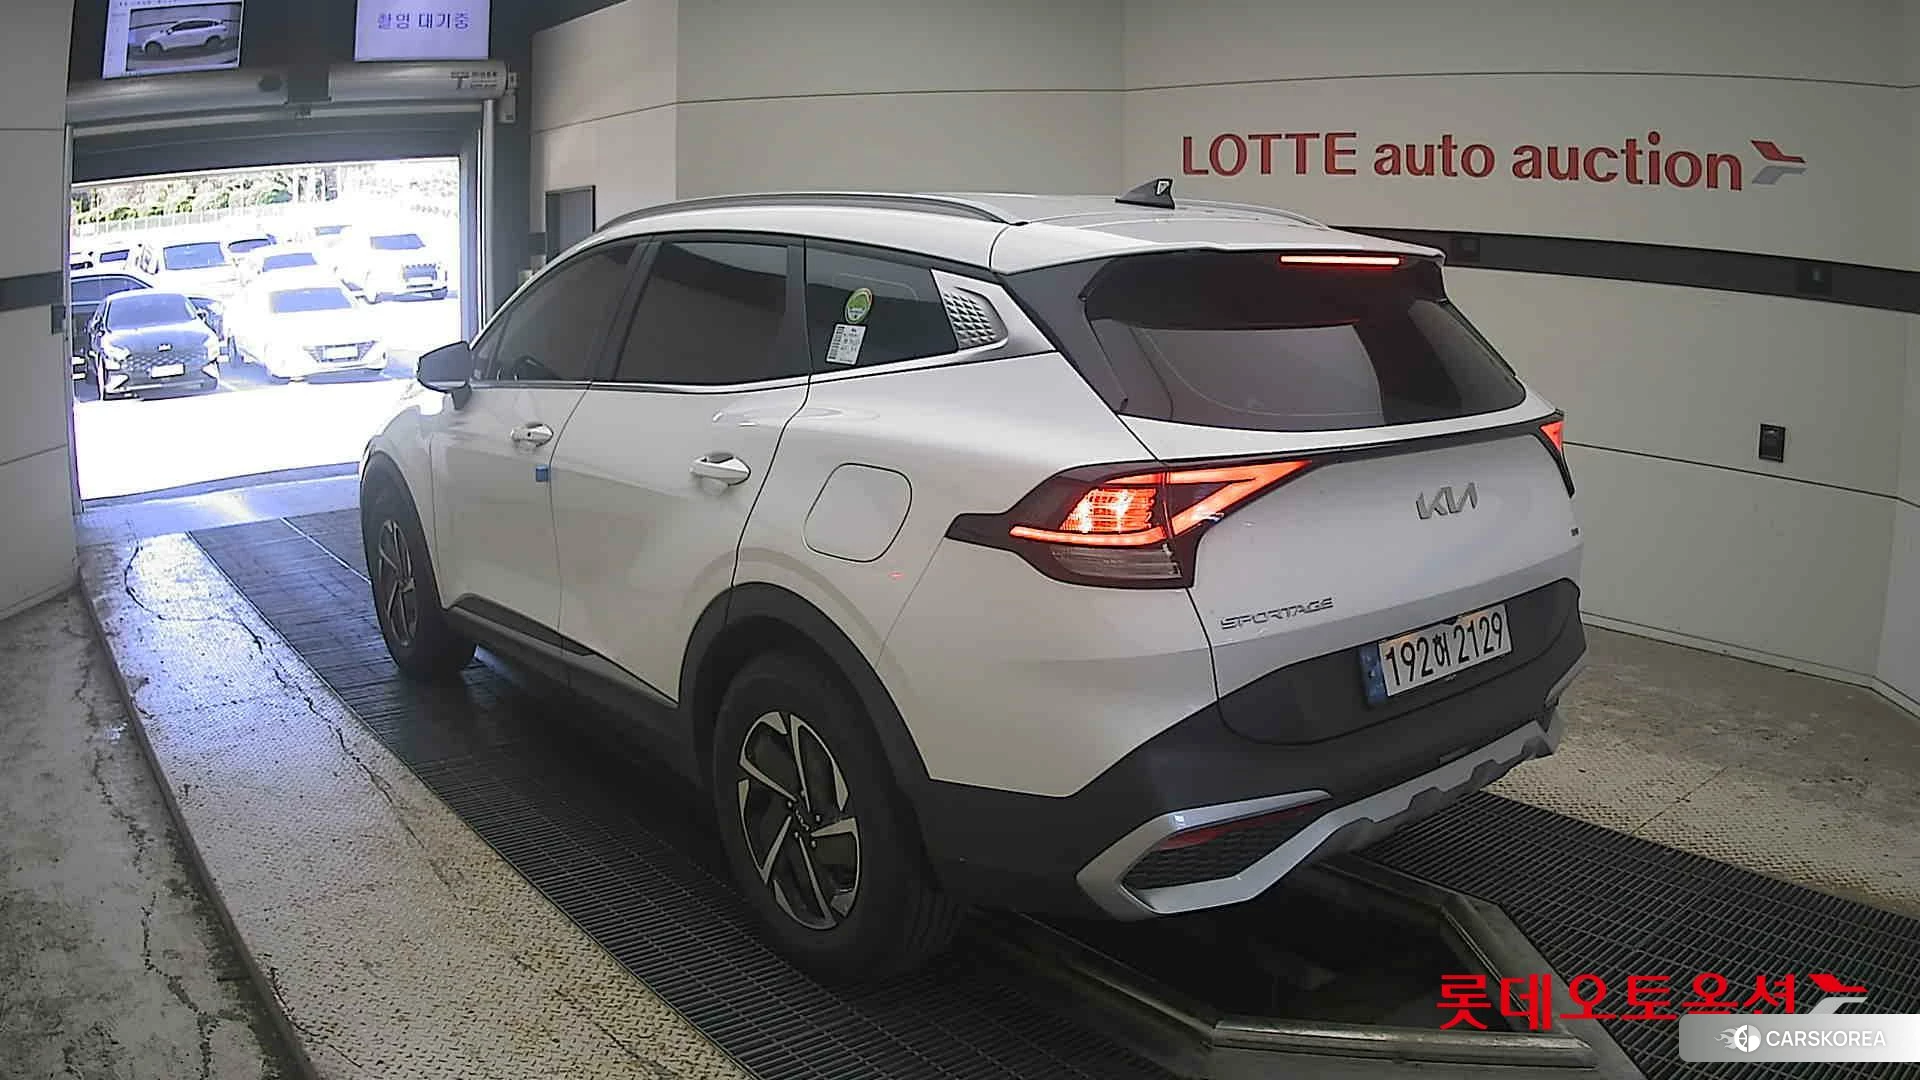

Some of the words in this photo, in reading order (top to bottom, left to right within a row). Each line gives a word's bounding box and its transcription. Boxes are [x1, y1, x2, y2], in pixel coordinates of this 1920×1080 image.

[418, 12, 469, 30] 대기중
[1183, 132, 1357, 177] LOTTE
[1374, 134, 1495, 178] auto
[1512, 132, 1743, 190] auction
[1220, 597, 1334, 630] SPORTAGE
